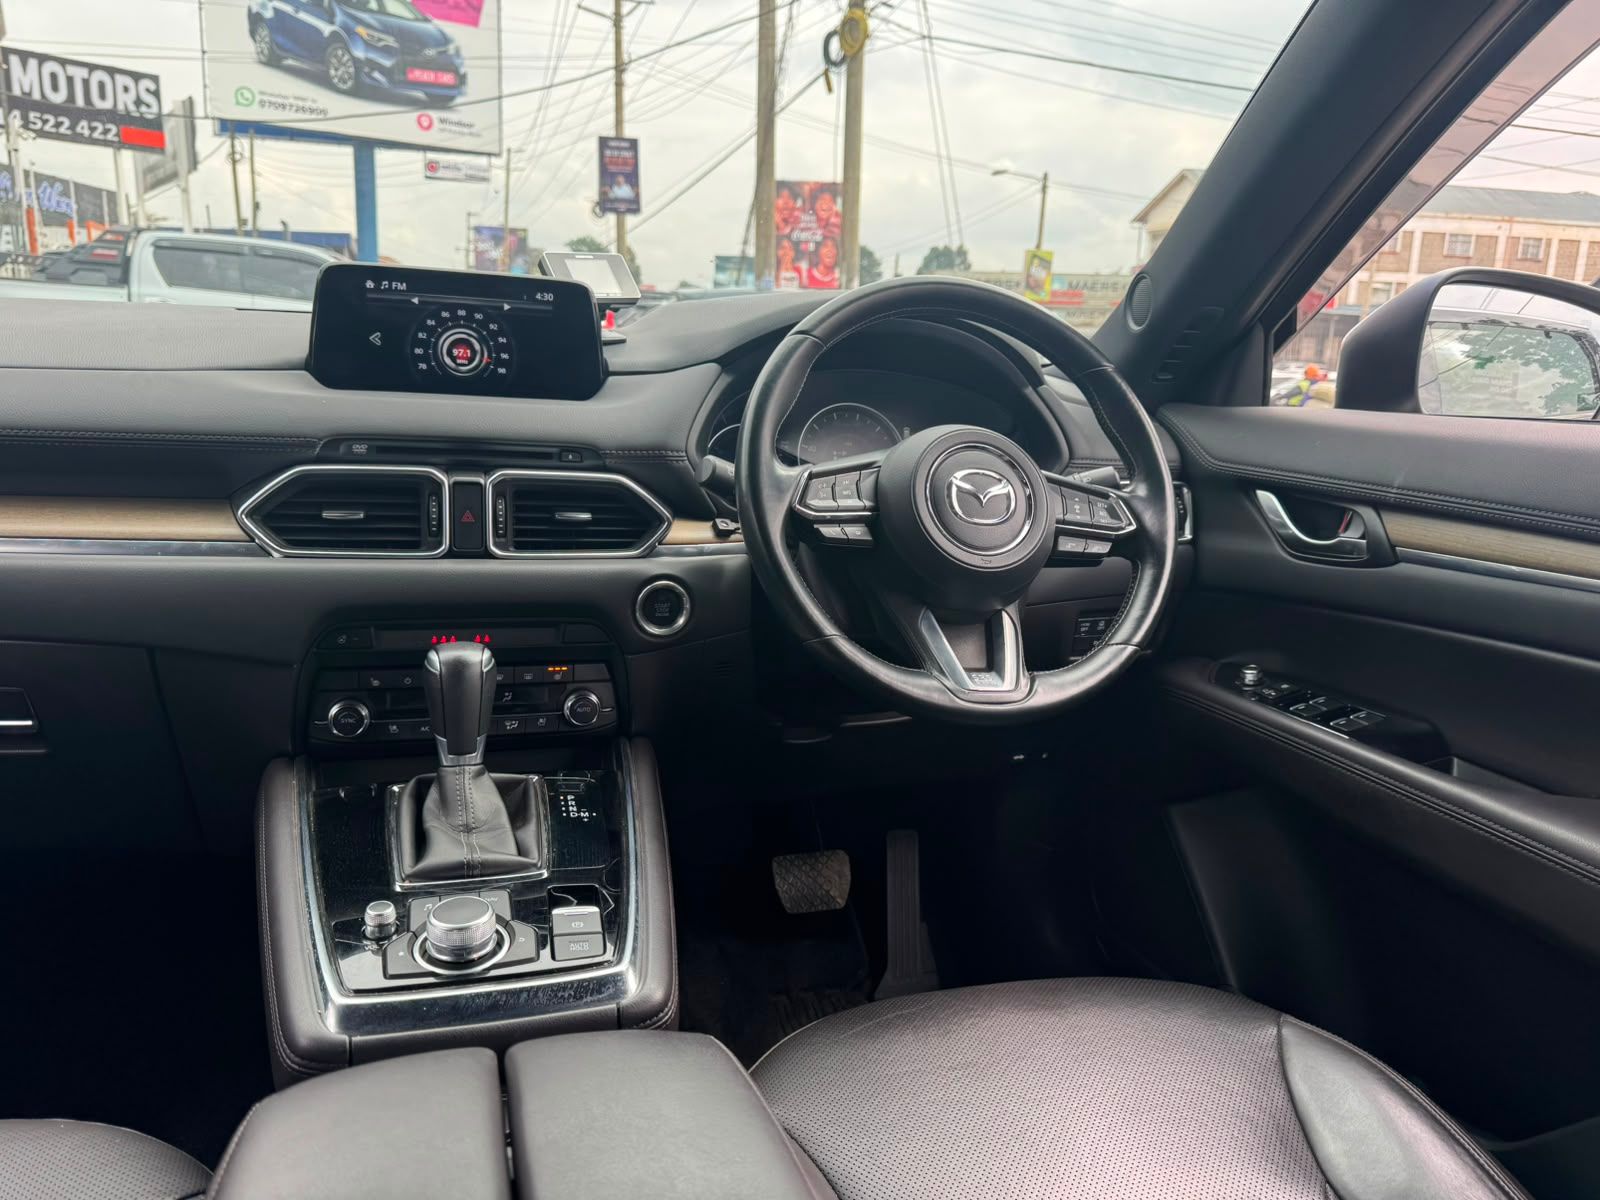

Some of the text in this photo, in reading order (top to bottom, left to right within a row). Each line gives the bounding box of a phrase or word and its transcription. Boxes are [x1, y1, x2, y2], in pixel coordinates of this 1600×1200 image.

[8, 54, 159, 118] MOTORS
[28, 111, 72, 135] 522
[75, 119, 120, 142] 422
[392, 282, 407, 291] FM
[535, 292, 554, 301] 4:30
[457, 309, 466, 317] 88
[489, 323, 498, 331] 92
[452, 348, 471, 358] 97.1
